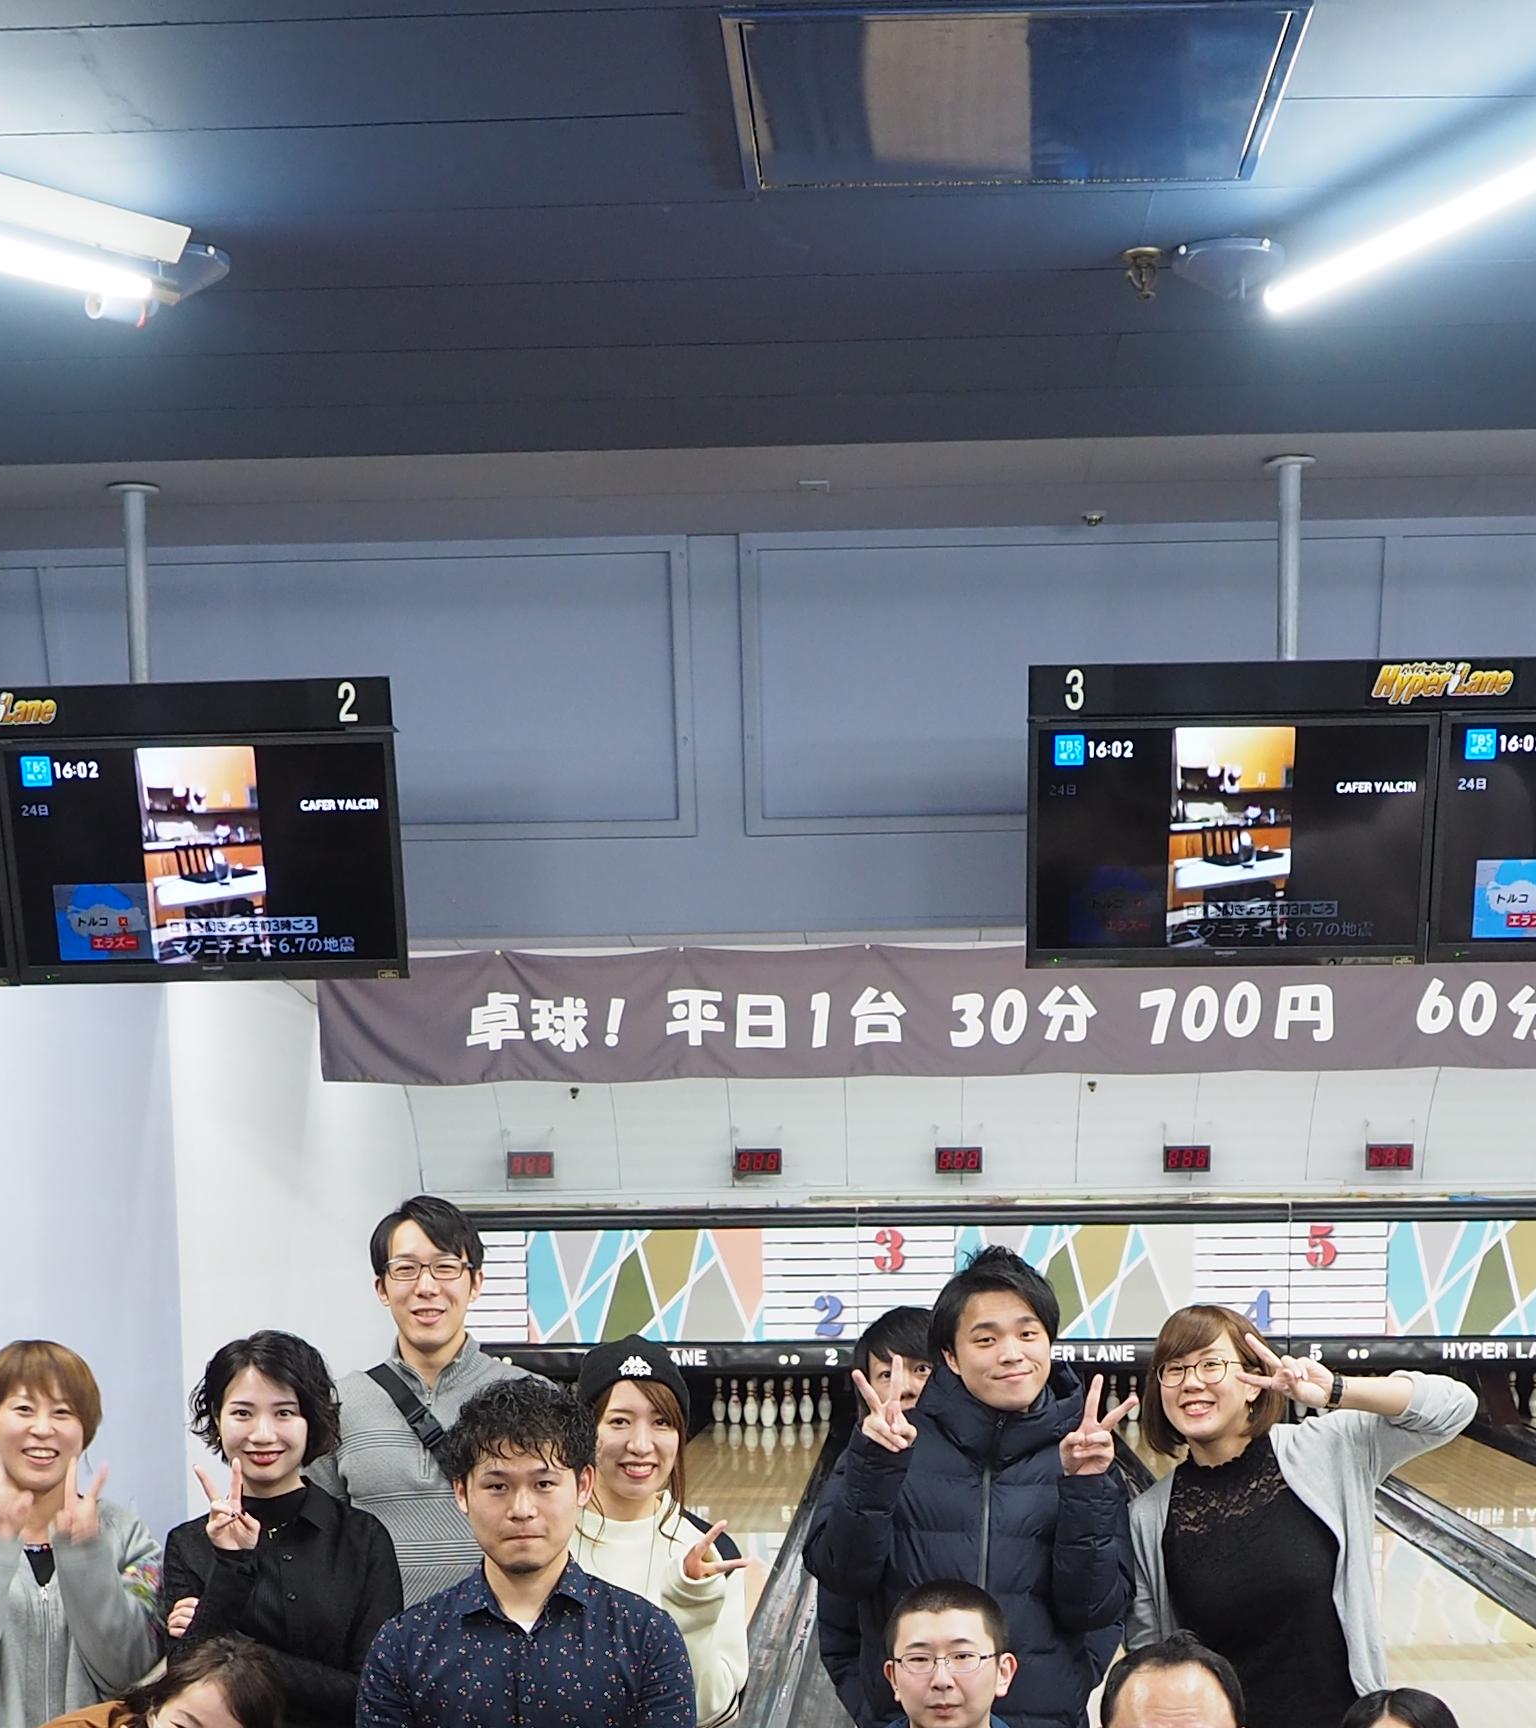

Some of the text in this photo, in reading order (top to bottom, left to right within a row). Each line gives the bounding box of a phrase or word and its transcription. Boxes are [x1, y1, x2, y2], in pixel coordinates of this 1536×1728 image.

[1064, 669, 1085, 711] 3
[1371, 663, 1514, 706] Hyper Lane
[0, 692, 58, 725] Lane
[337, 681, 358, 722] 2
[1088, 740, 1134, 759] 16:02
[53, 760, 100, 779] 16:02
[1336, 780, 1416, 793] CAFER YALCIN
[1457, 777, 1487, 791] 24日
[21, 804, 48, 816] 24日
[300, 800, 335, 811] CAFER
[1496, 891, 1529, 904] トルコ
[76, 917, 109, 928] トルコ
[92, 937, 137, 949] エラズー
[666, 986, 908, 1049] 平日1台
[950, 984, 1099, 1046] 30分
[1139, 981, 1335, 1045] 700円
[874, 1228, 905, 1273] 3
[1305, 1224, 1336, 1268] 5
[813, 1294, 845, 1337] 2
[1244, 1289, 1273, 1332] 4
[671, 1348, 838, 1367] ANE 2
[1050, 1344, 1136, 1362] ER LANE
[1308, 1343, 1323, 1361] 5
[1441, 1341, 1510, 1360] HYPER
